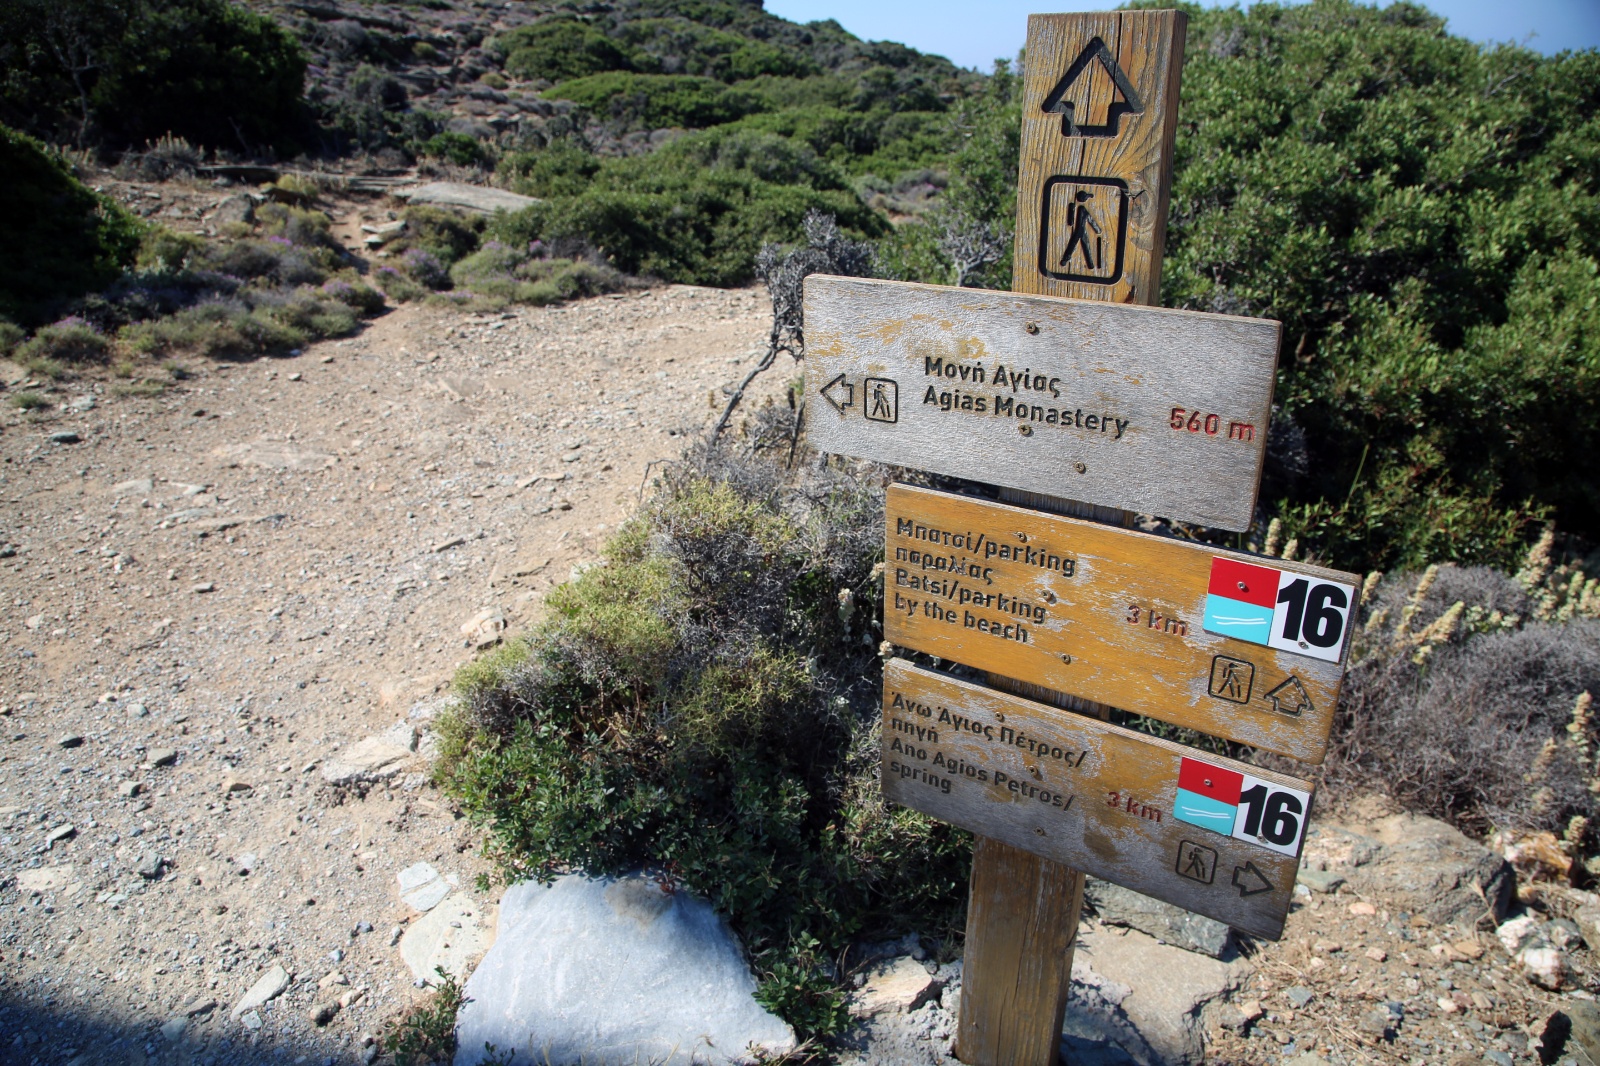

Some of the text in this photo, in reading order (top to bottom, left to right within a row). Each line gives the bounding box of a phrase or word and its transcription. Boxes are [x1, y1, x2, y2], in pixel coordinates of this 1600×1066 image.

[925, 356, 1061, 398] Μονή Αγίας
[923, 385, 1130, 439] Agias Monastery
[1170, 407, 1256, 441] 560 m
[895, 593, 1029, 643] by the beach
[896, 568, 1046, 625] Batsi/parking
[1127, 605, 1188, 636] 3 km
[1277, 578, 1348, 648] 16
[890, 760, 952, 794] spring
[891, 737, 1074, 812] Ano Agios Petros/
[1107, 791, 1162, 823] 3 km
[1241, 783, 1303, 846] 16
